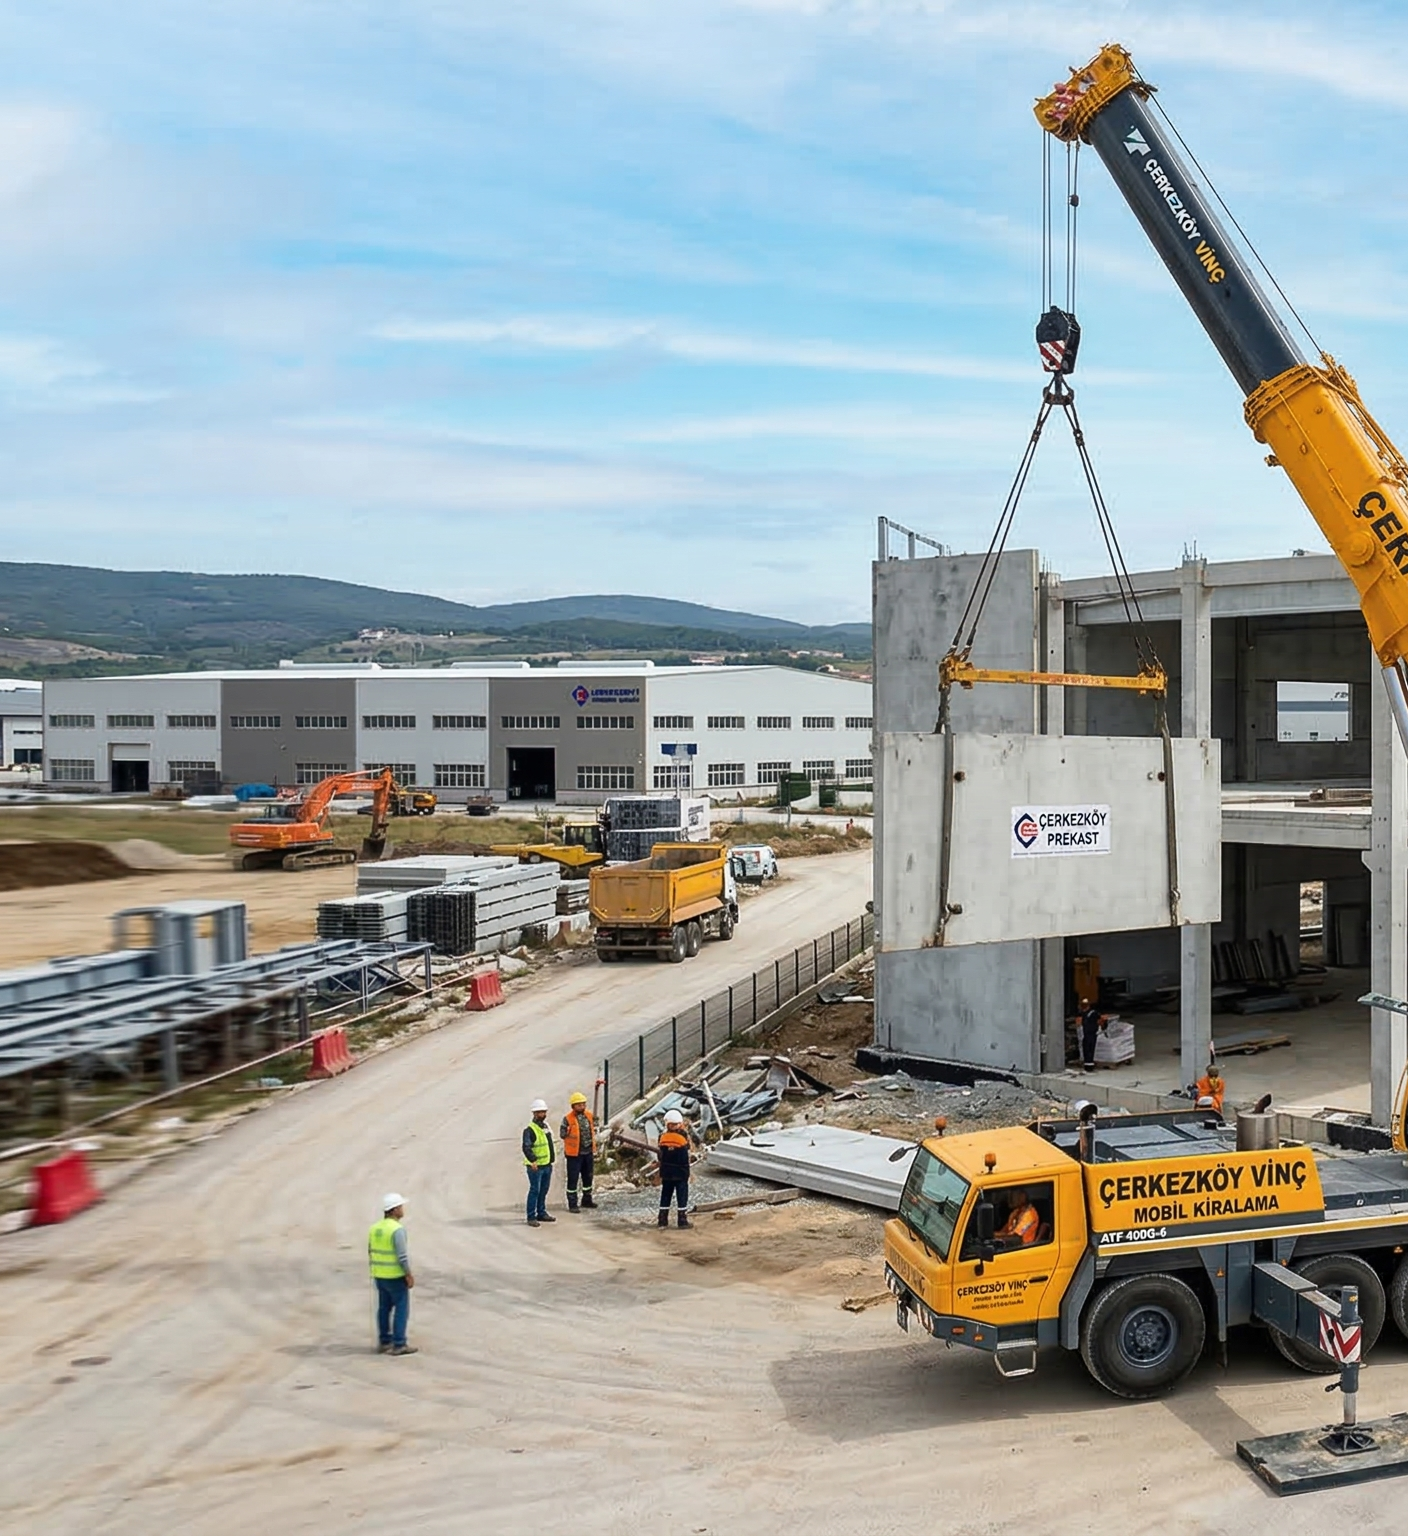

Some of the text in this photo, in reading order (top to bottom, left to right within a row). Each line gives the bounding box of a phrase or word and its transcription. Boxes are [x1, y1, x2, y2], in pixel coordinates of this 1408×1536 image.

[1195, 240, 1226, 284] VİNÇ
[1047, 832, 1099, 846] PREKAST
[1099, 1158, 1307, 1209] ÇERKEZKÖY VİNÇ
[1133, 1195, 1280, 1224] MOBİL KİRALAMA
[1100, 1231, 1124, 1244] ATF
